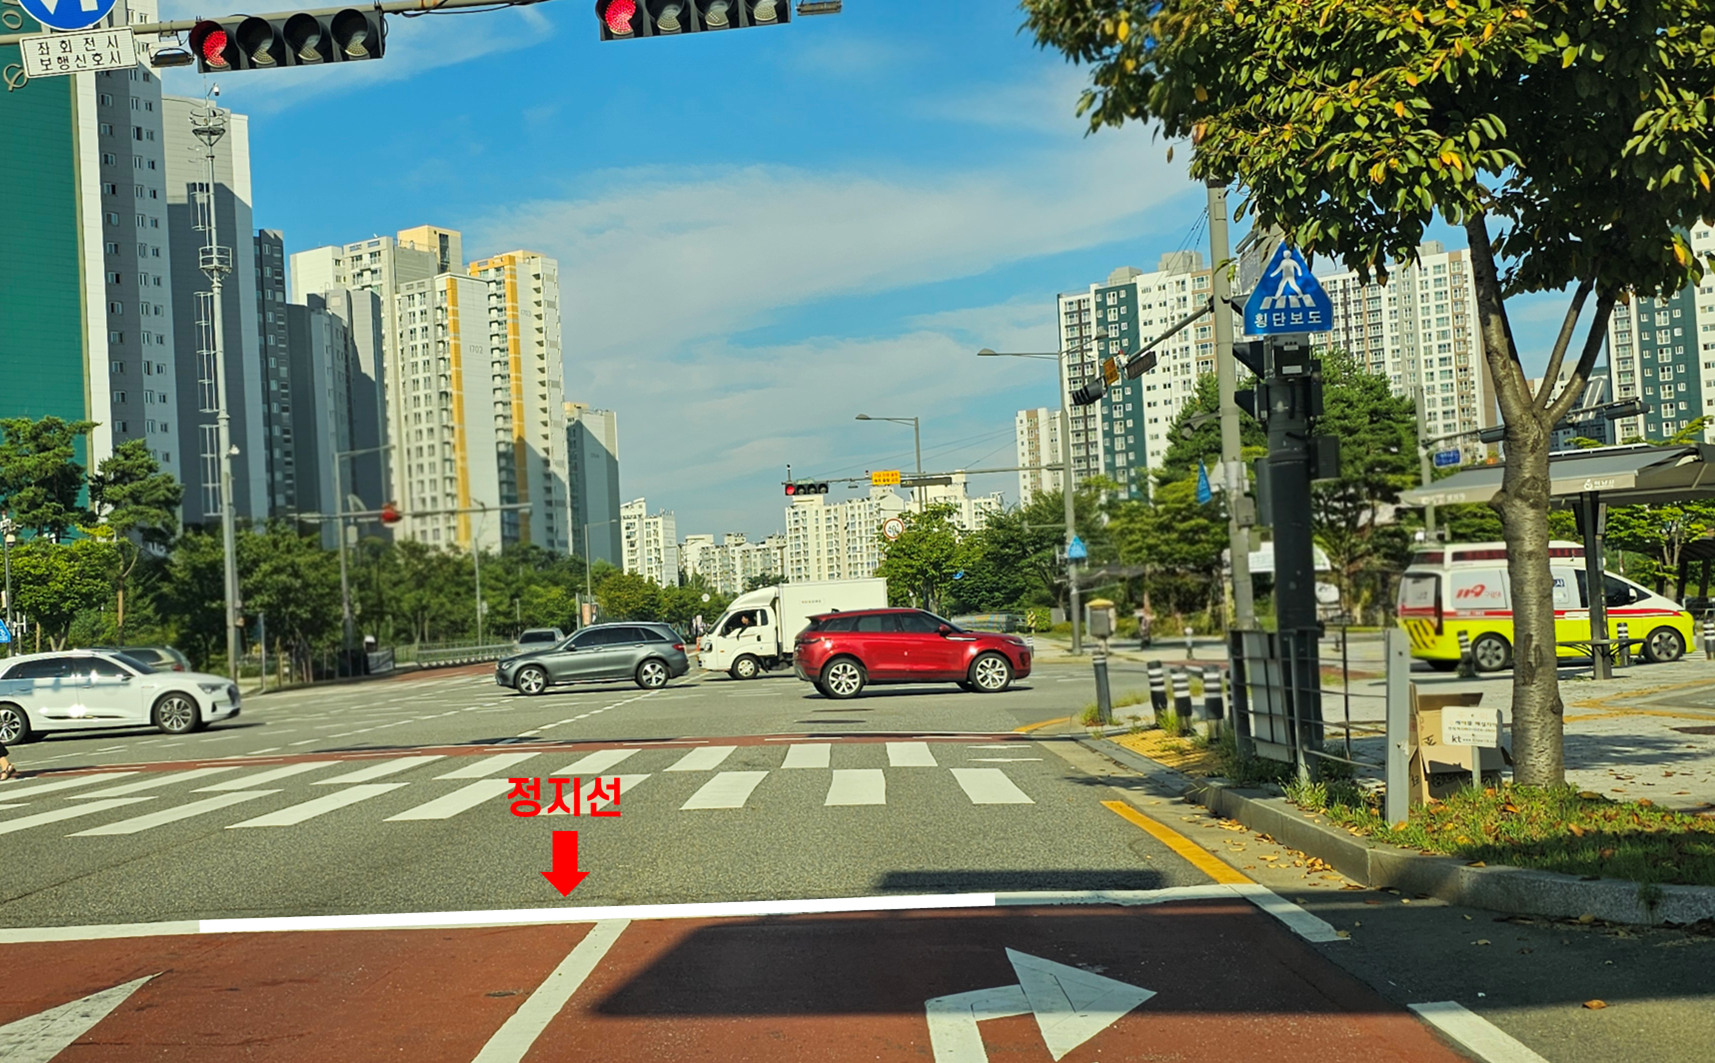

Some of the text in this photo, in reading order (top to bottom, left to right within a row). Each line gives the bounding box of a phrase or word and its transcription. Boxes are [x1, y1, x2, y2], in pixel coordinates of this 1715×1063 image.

[40, 50, 121, 71] 보행신호시
[1254, 310, 1322, 328] 횡단보도
[1451, 735, 1461, 743] kt
